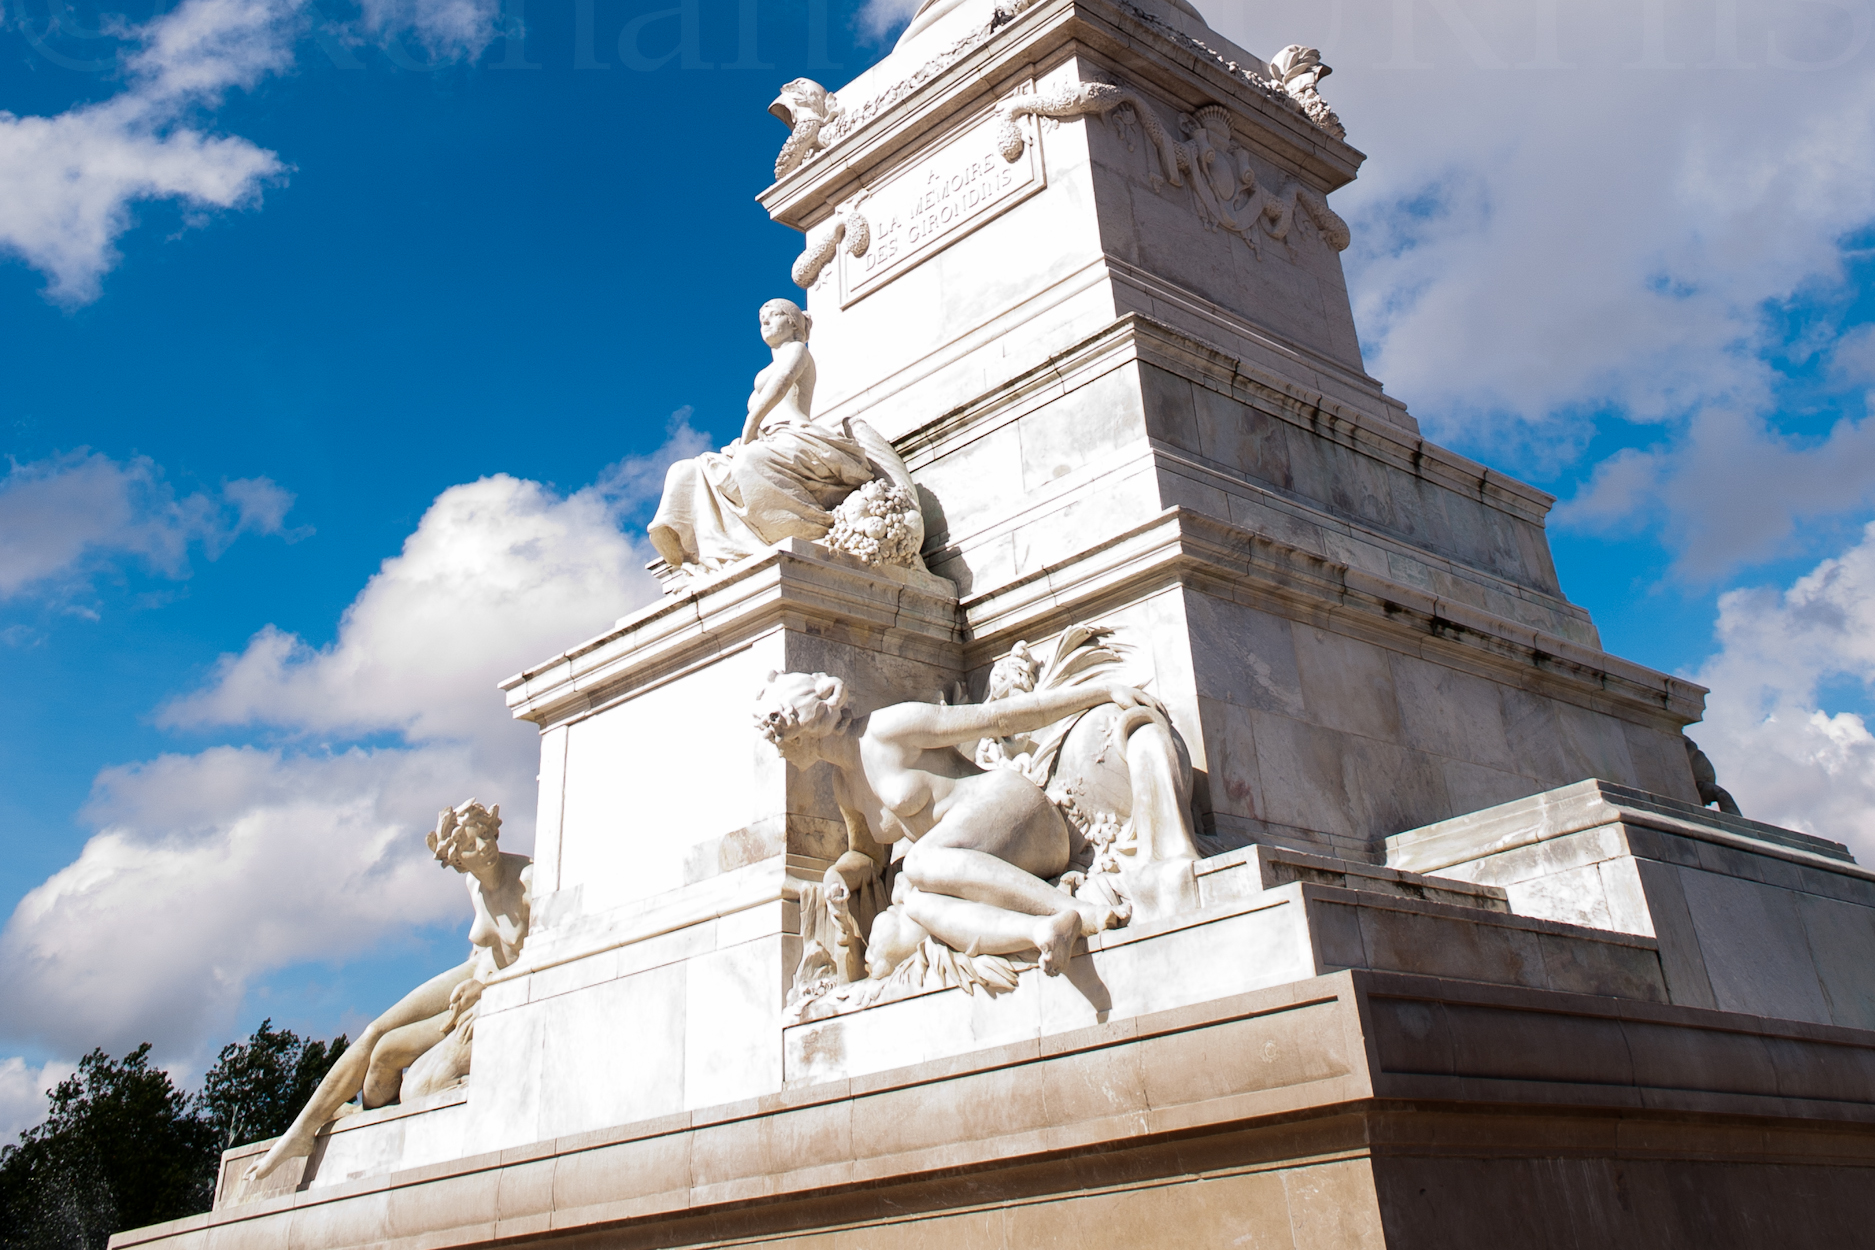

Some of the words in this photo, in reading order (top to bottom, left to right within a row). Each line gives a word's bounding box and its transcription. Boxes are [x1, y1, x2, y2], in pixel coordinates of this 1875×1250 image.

[866, 237, 898, 272] DES
[909, 168, 1012, 244] GIRONDINS
[878, 215, 902, 240] LA
